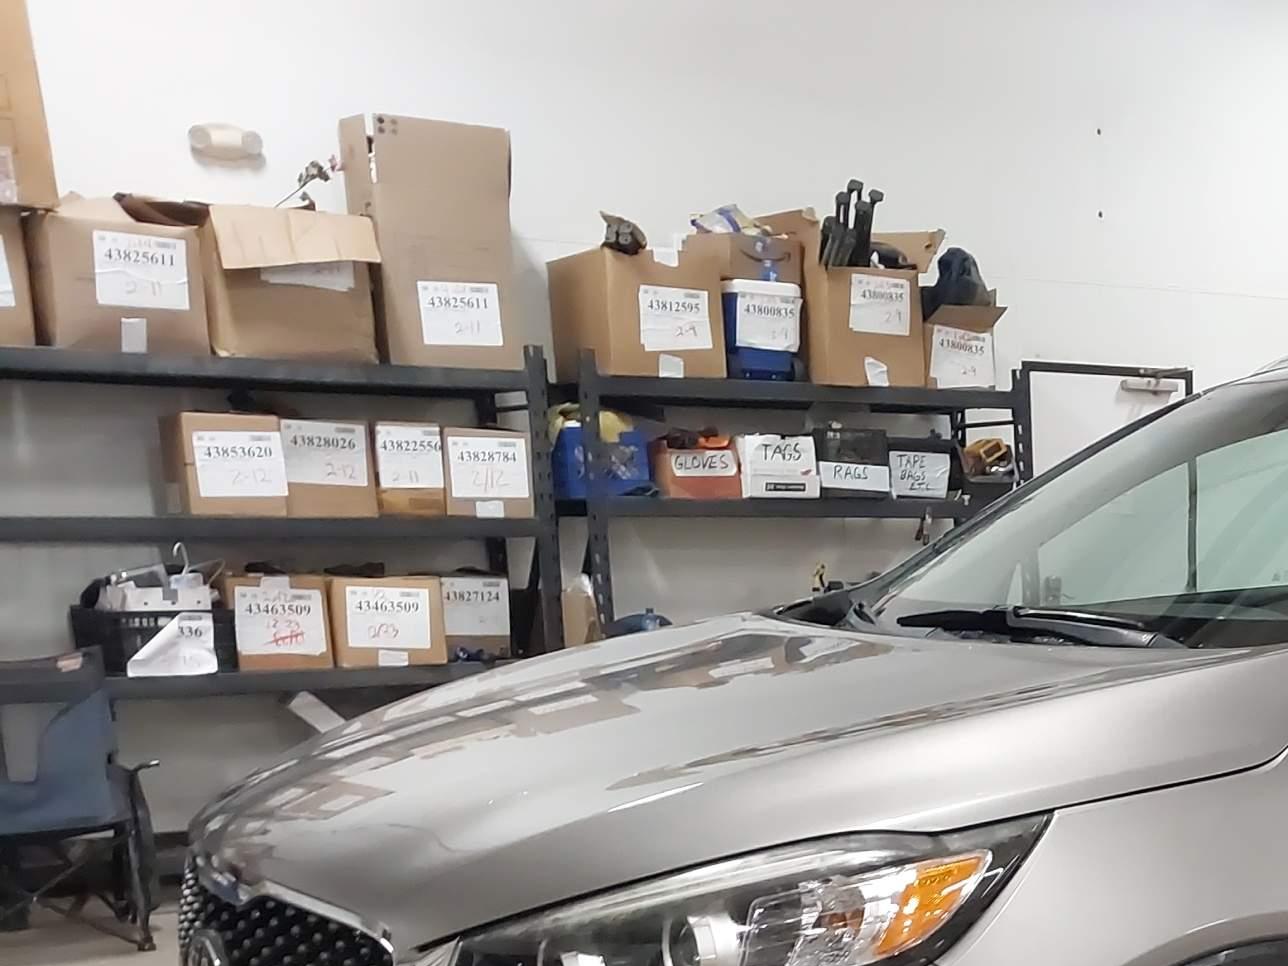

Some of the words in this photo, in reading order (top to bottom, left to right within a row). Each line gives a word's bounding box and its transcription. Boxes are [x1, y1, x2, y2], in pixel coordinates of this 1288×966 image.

[104, 248, 174, 266] 43825611
[861, 288, 905, 301] 43800835
[428, 296, 488, 309] 43825611
[648, 299, 701, 314] 43812595
[744, 303, 795, 319] 43800835
[939, 338, 985, 355] 43800835
[290, 434, 356, 450] 43828026
[380, 440, 441, 451] 43822556
[203, 446, 273, 459] 43853620
[457, 451, 517, 463] 43828784
[762, 443, 802, 461] TAGS
[674, 454, 730, 471] GLOVES
[897, 454, 927, 469] TAPE
[833, 464, 870, 481] RAGS
[900, 469, 926, 482] BAGS
[444, 591, 500, 602] 43827124
[245, 603, 311, 616] 43463509
[355, 600, 420, 613] 43463509
